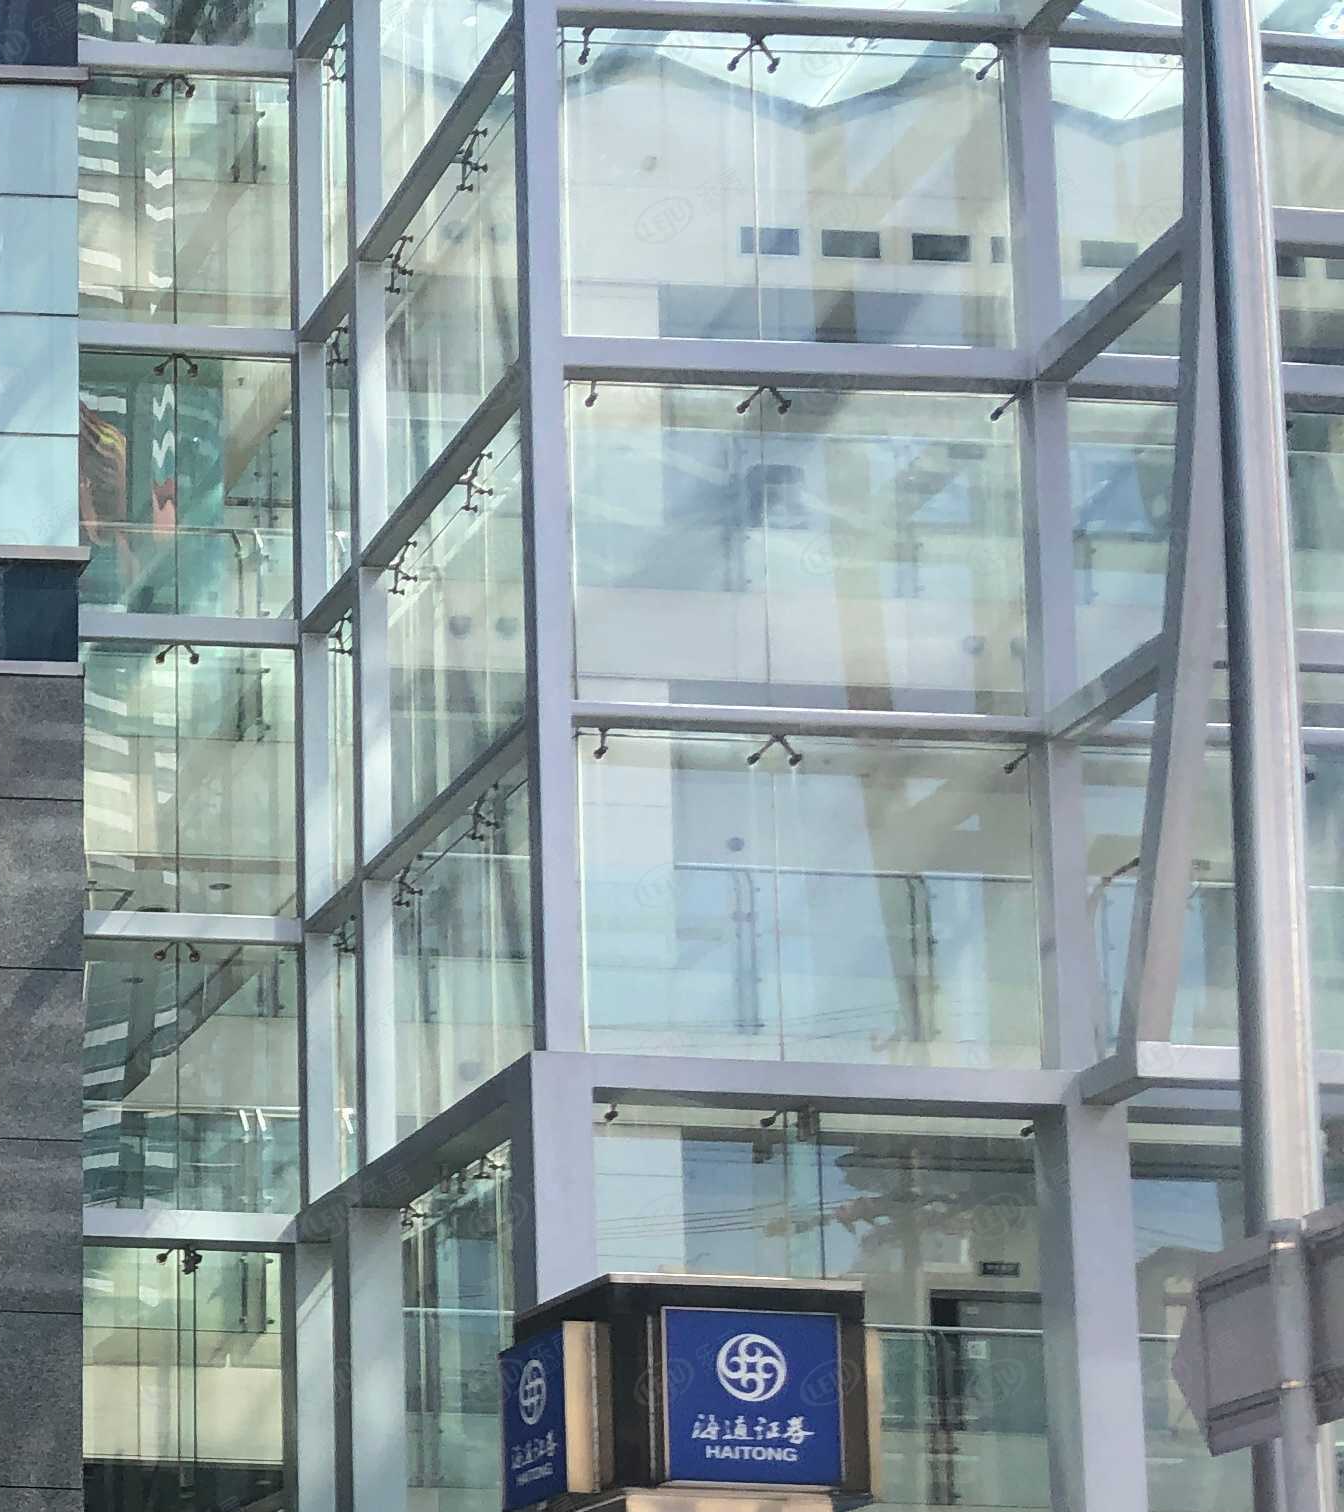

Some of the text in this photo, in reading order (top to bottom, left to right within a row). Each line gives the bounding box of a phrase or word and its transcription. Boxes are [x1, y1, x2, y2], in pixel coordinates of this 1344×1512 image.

[691, 1413, 815, 1445] 海通证券
[705, 1444, 799, 1462] HAITONG
